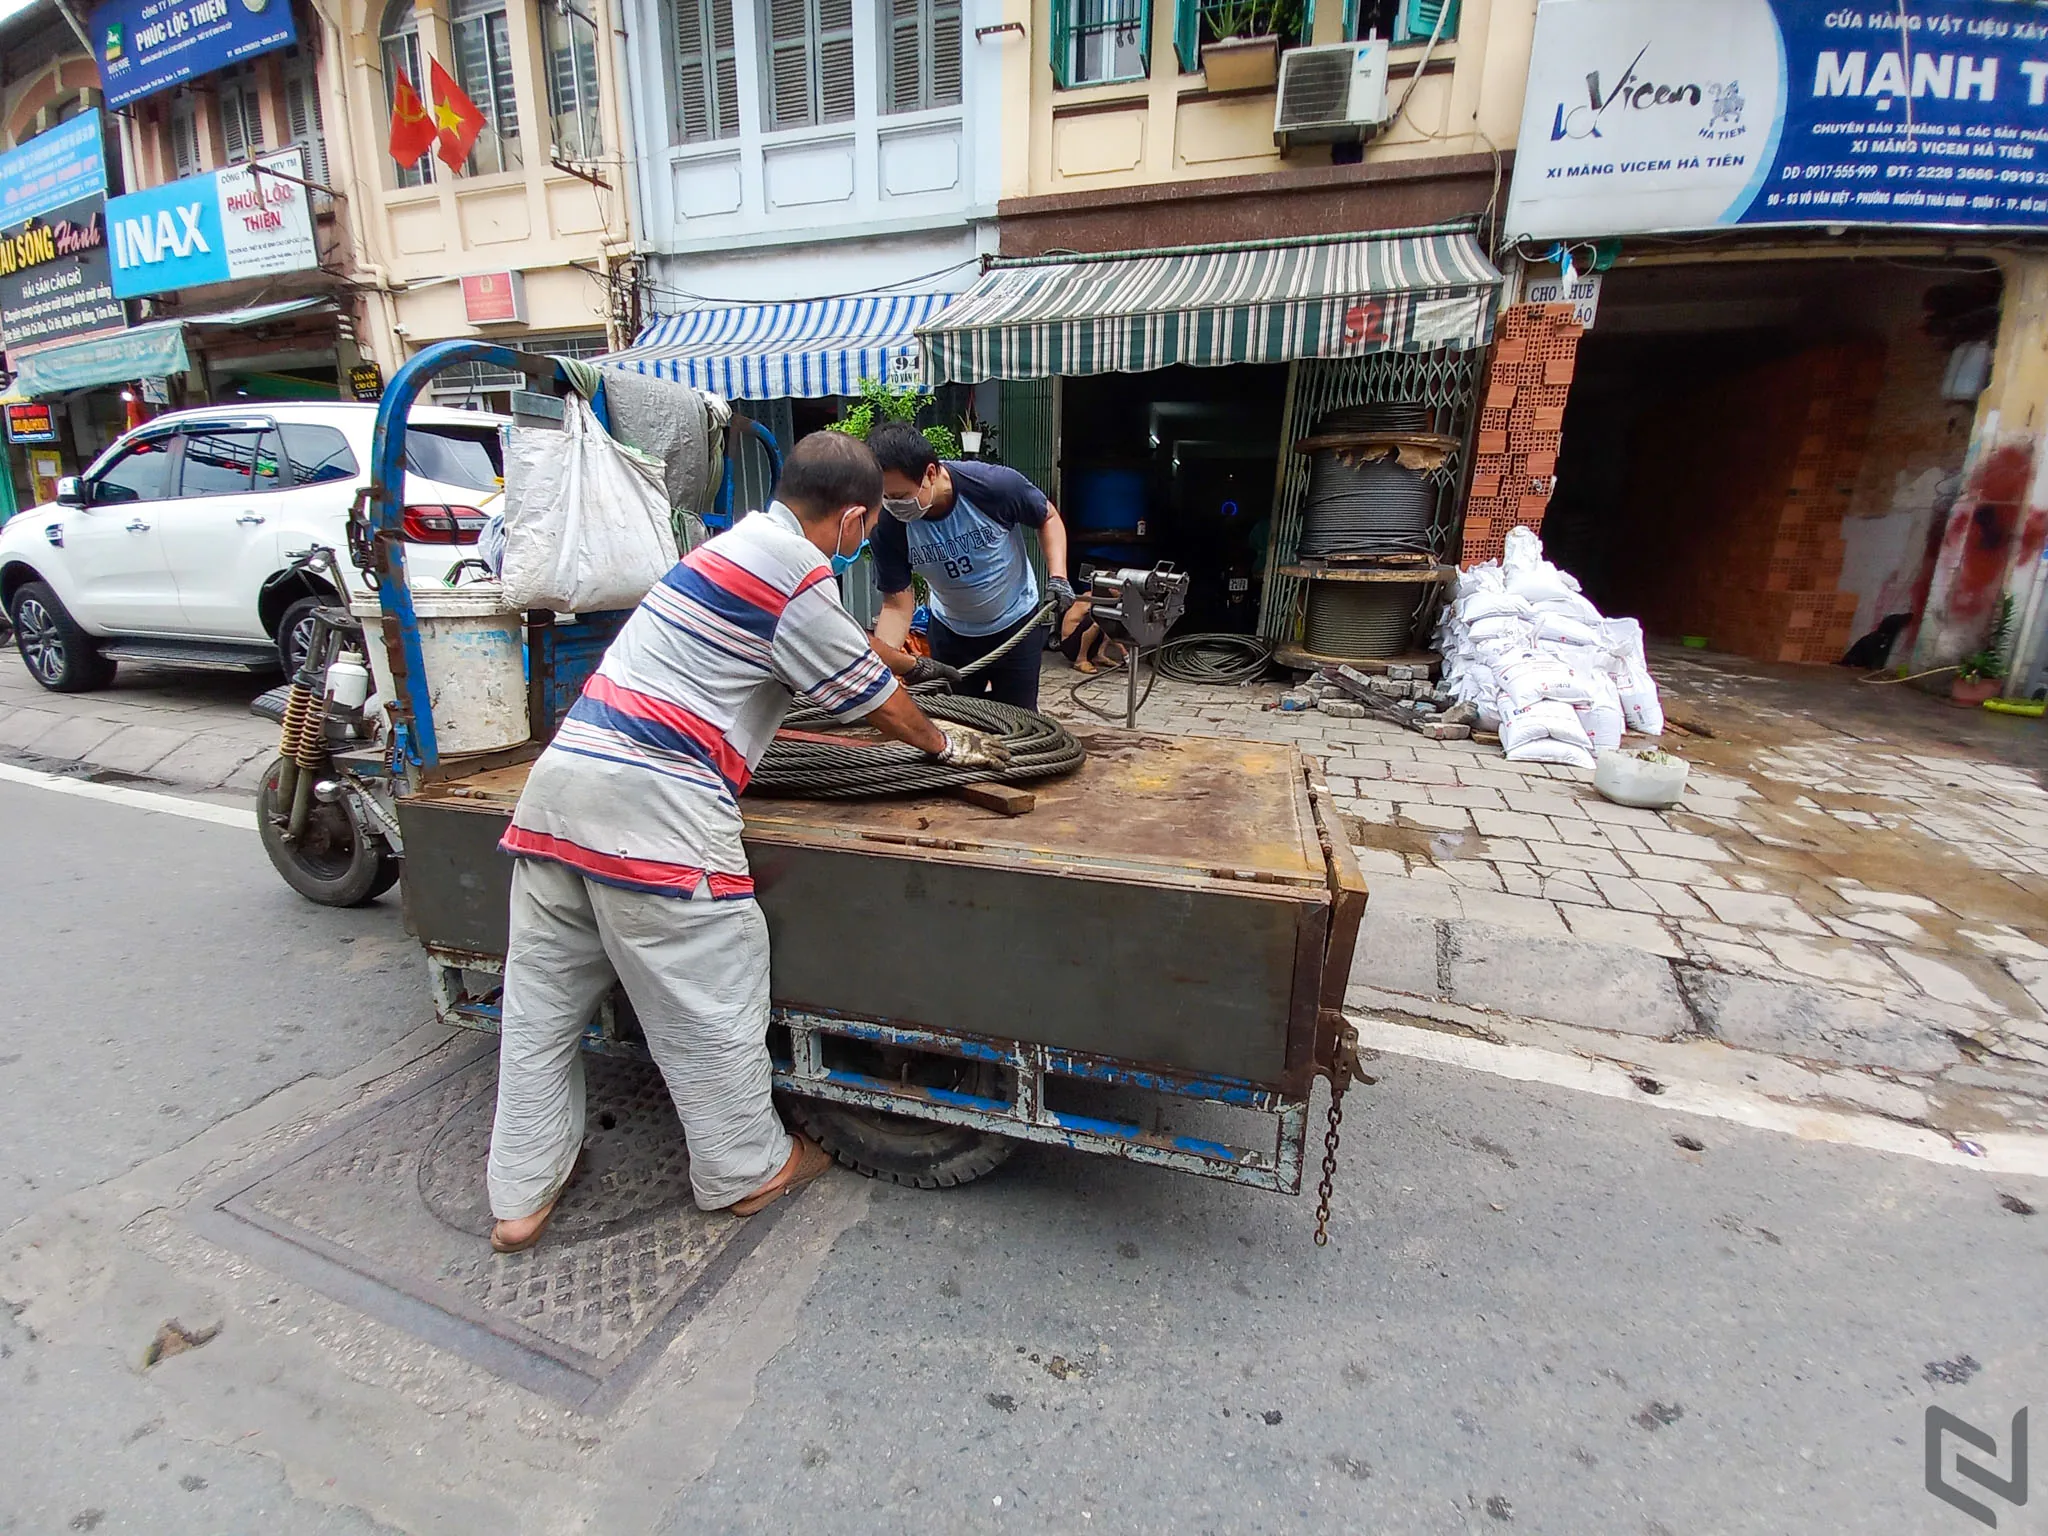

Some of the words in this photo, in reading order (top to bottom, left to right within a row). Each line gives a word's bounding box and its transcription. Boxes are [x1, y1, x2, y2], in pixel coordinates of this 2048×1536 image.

[136, 22, 167, 52] PHÚC
[166, 12, 189, 37] LỘC
[1824, 8, 1863, 28] CỬA
[1868, 12, 1922, 31] HÀNG
[1926, 14, 1963, 36] VẬT
[1966, 18, 2009, 40] LIỆU
[1812, 50, 1999, 111] MẠNH
[1850, 140, 1868, 154] XI
[1871, 138, 1918, 153] MĂNG
[1921, 141, 1970, 156] VICEM
[1972, 140, 1995, 157] HÀ
[1998, 143, 2035, 160] TIÊN
[1546, 167, 1561, 179] XI
[1566, 162, 1615, 178] MĂNG
[1620, 159, 1672, 173] VICEM
[1677, 156, 1700, 169] HÀ
[1706, 153, 1746, 168] TIÊN
[1916, 166, 1954, 180] 2228
[17, 217, 55, 268] SỐNG
[114, 202, 211, 270] INAX
[1531, 285, 1557, 302] CHO
[1561, 279, 1595, 301] HUÊ
[910, 525, 997, 566] ANDOVER
[944, 555, 975, 579] 83
